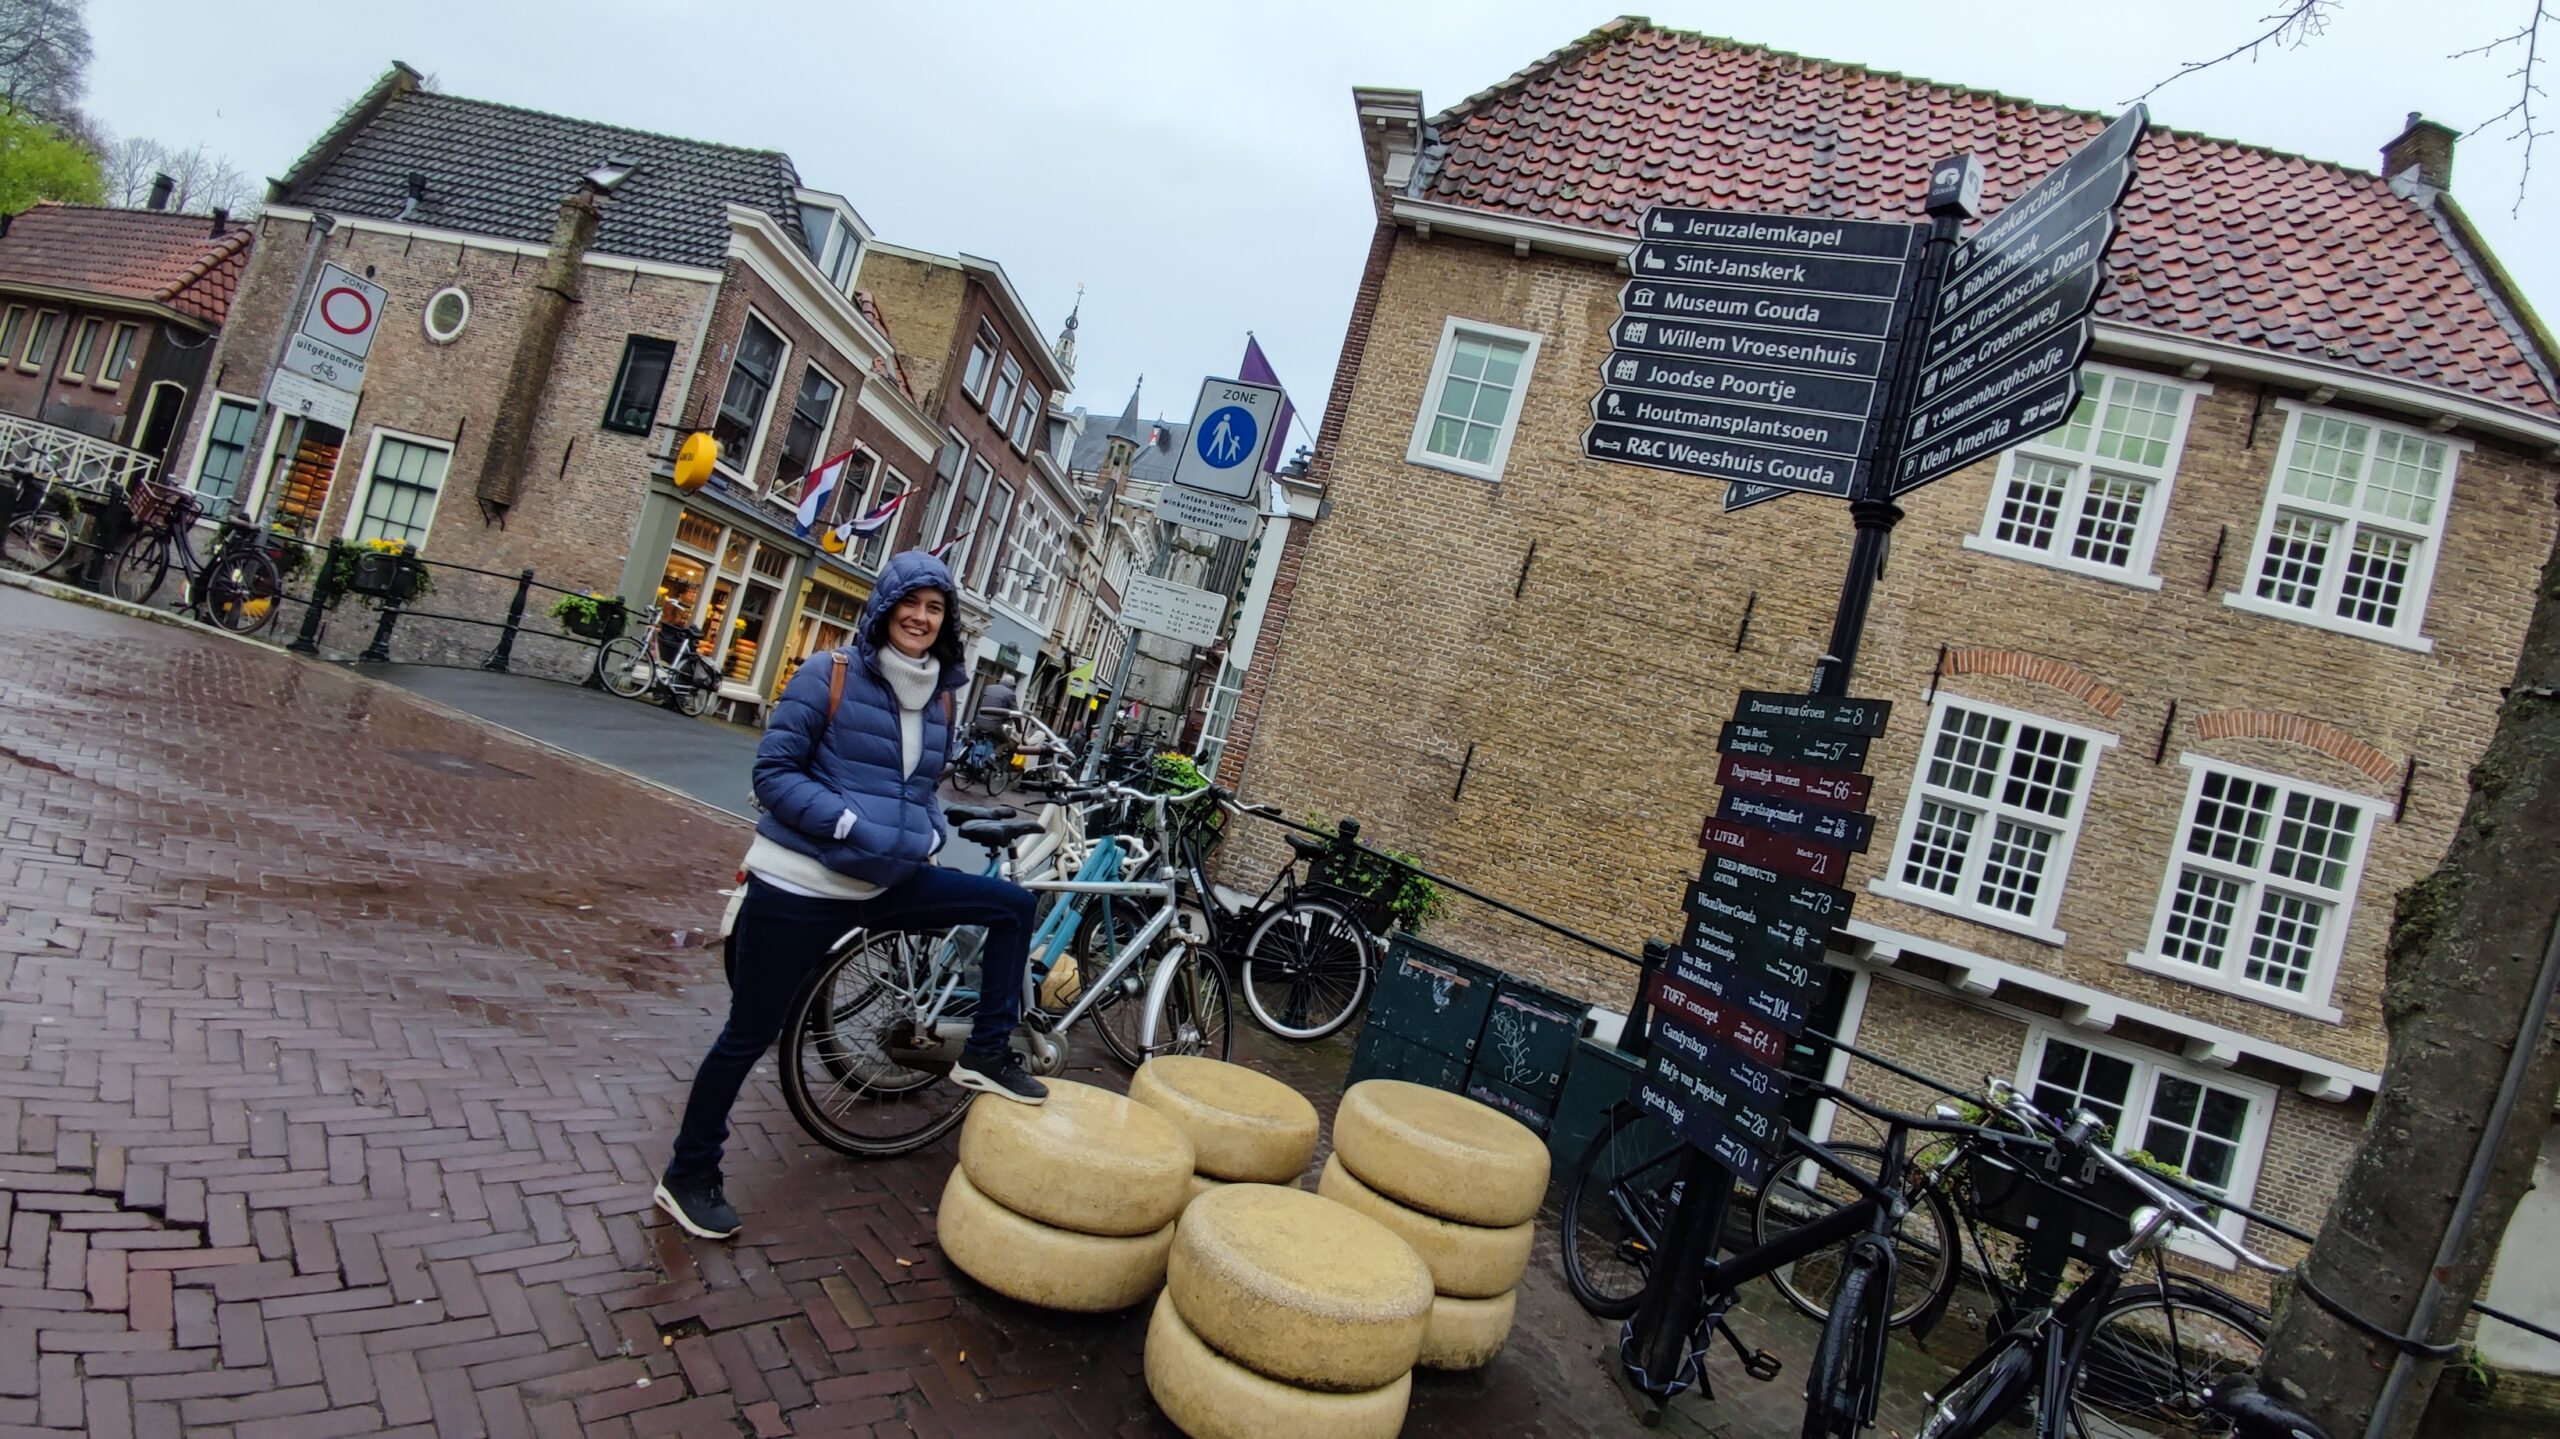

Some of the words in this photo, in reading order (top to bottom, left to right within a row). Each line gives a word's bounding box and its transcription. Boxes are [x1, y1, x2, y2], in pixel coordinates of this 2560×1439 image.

[1973, 167, 2072, 259] Streekarchief
[1684, 218, 1843, 248] Jeruzalemkapel
[1674, 254, 1807, 283] Sint-Janskerk
[1962, 233, 2041, 302] Bibliotheek
[341, 275, 371, 294] ZONE
[1950, 323, 1967, 344] De
[1969, 266, 2049, 332] Utrechtsche
[2052, 240, 2090, 277] Dom
[1664, 292, 1749, 317] Museum
[1754, 300, 1821, 323] Gouda
[1658, 327, 1726, 352] Willem
[1731, 336, 1857, 366] Vroesenhuis
[1940, 354, 1976, 387] Huize
[1977, 299, 2061, 362] Groeneweg
[296, 340, 365, 373] uitgezonderd
[1647, 366, 1715, 390] Joodse
[1720, 374, 1796, 402] Poortje
[1939, 346, 2064, 426] Swanenburghshofje
[1223, 389, 1259, 405] ZONE
[1636, 403, 1829, 443] Houtmansplantsoen
[1920, 445, 1951, 474] Klein
[1952, 418, 2011, 458] Amerika
[1626, 437, 1667, 459] R&C
[1668, 442, 1763, 475] Weeshuis
[1767, 459, 1836, 486] Gouda
[1163, 498, 1248, 527] winkelopeningstijden
[1209, 500, 1236, 514] buiten
[1180, 511, 1223, 529] toegestaan
[1750, 700, 1783, 715] Dromen
[1784, 706, 1800, 717] van
[1800, 704, 1826, 719] Groen
[1852, 707, 1864, 726] 8
[1759, 742, 1774, 756] City
[1829, 742, 1847, 761] 57
[1775, 773, 1800, 788] wonen
[1834, 780, 1850, 800] 66
[1714, 829, 1745, 848] LIVERA
[1717, 857, 1737, 872] USED
[1736, 863, 1777, 883] PRODUCTS
[1811, 853, 1828, 875] 21
[1713, 872, 1738, 888] GOUDA
[1814, 892, 1833, 915] 73
[1682, 951, 1693, 965] Van
[1694, 955, 1712, 973] Herk
[1677, 965, 1723, 997] Makelaardij
[1790, 964, 1808, 987] 90
[1686, 1000, 1719, 1025] concept
[1772, 997, 1789, 1022] 104
[1662, 1022, 1708, 1060] Candyshop
[1753, 1030, 1769, 1053] 64
[1659, 1057, 1679, 1082] Hofje
[1680, 1072, 1694, 1088] van
[1752, 1071, 1769, 1094] 63
[1642, 1085, 1666, 1111] Optiek
[1666, 1099, 1685, 1125] Rigi
[1750, 1113, 1768, 1137] 28
[1732, 1143, 1748, 1167] 70
